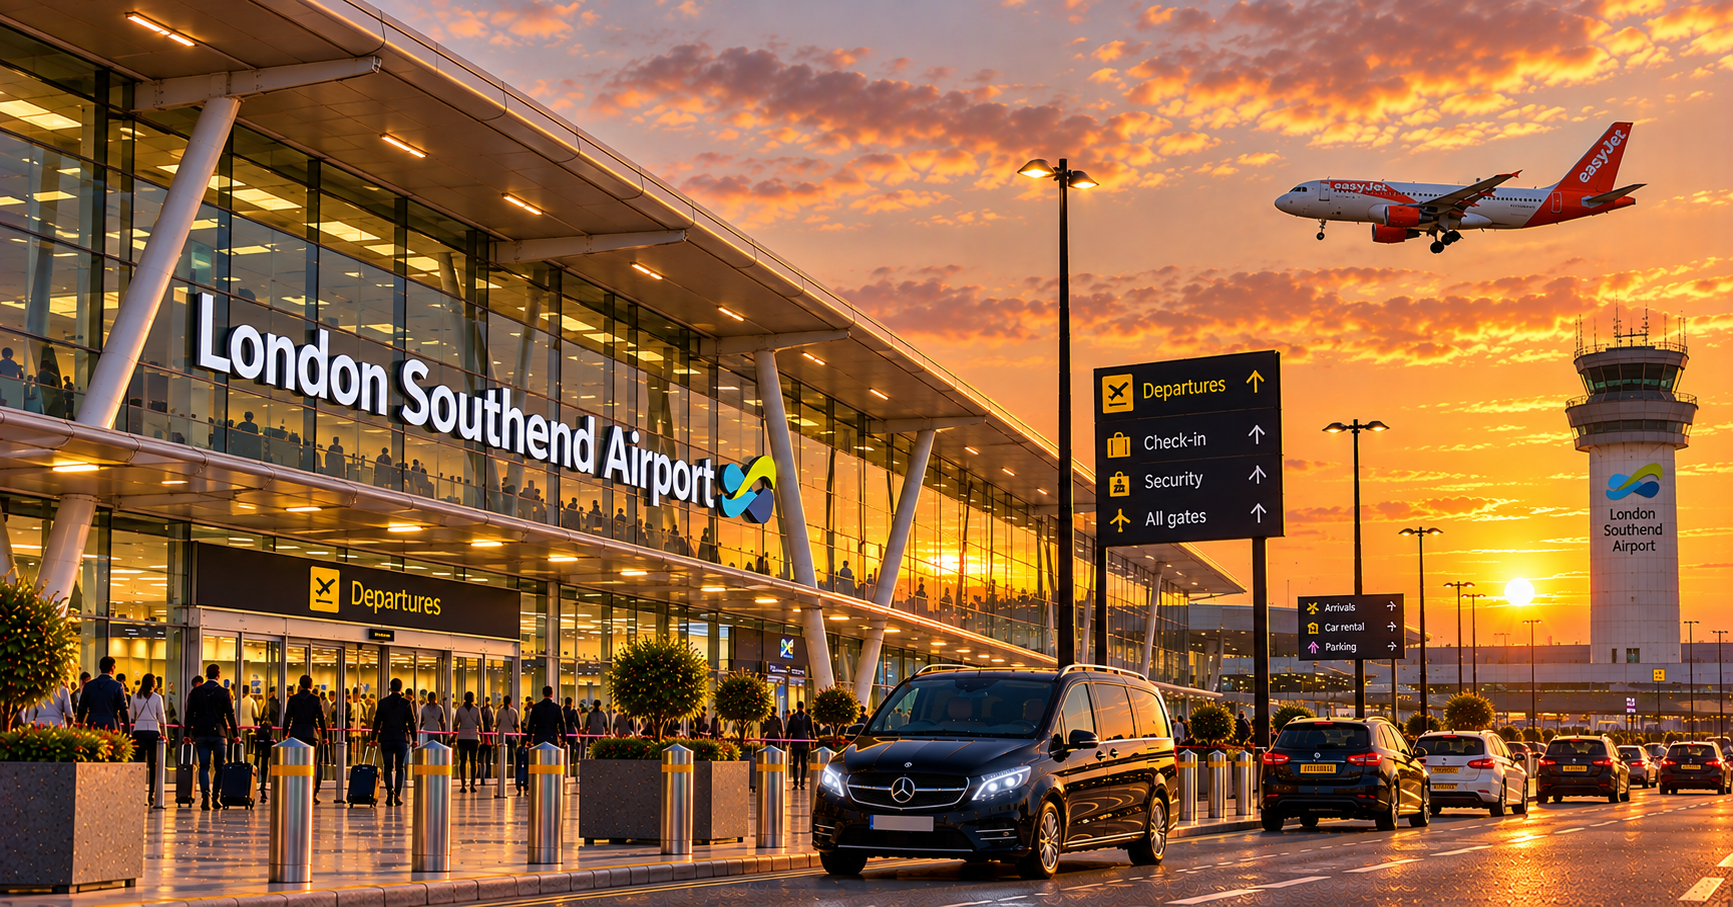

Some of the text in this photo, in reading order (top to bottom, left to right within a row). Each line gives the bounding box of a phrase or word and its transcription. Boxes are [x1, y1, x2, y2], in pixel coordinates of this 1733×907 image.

[1578, 129, 1626, 183] easyJet
[1142, 377, 1226, 402] Departures
[198, 292, 716, 508] London Southend Airport
[1144, 431, 1207, 451] Check-in
[1144, 471, 1204, 490] Security
[1145, 509, 1207, 529] All gates
[1609, 506, 1656, 521] London
[1603, 522, 1663, 537] Southend
[1612, 539, 1656, 555] Airport
[350, 579, 442, 617] Departures
[1324, 602, 1356, 612] Arrivals
[1324, 621, 1365, 632] Car rental
[1325, 642, 1357, 653] Parking
